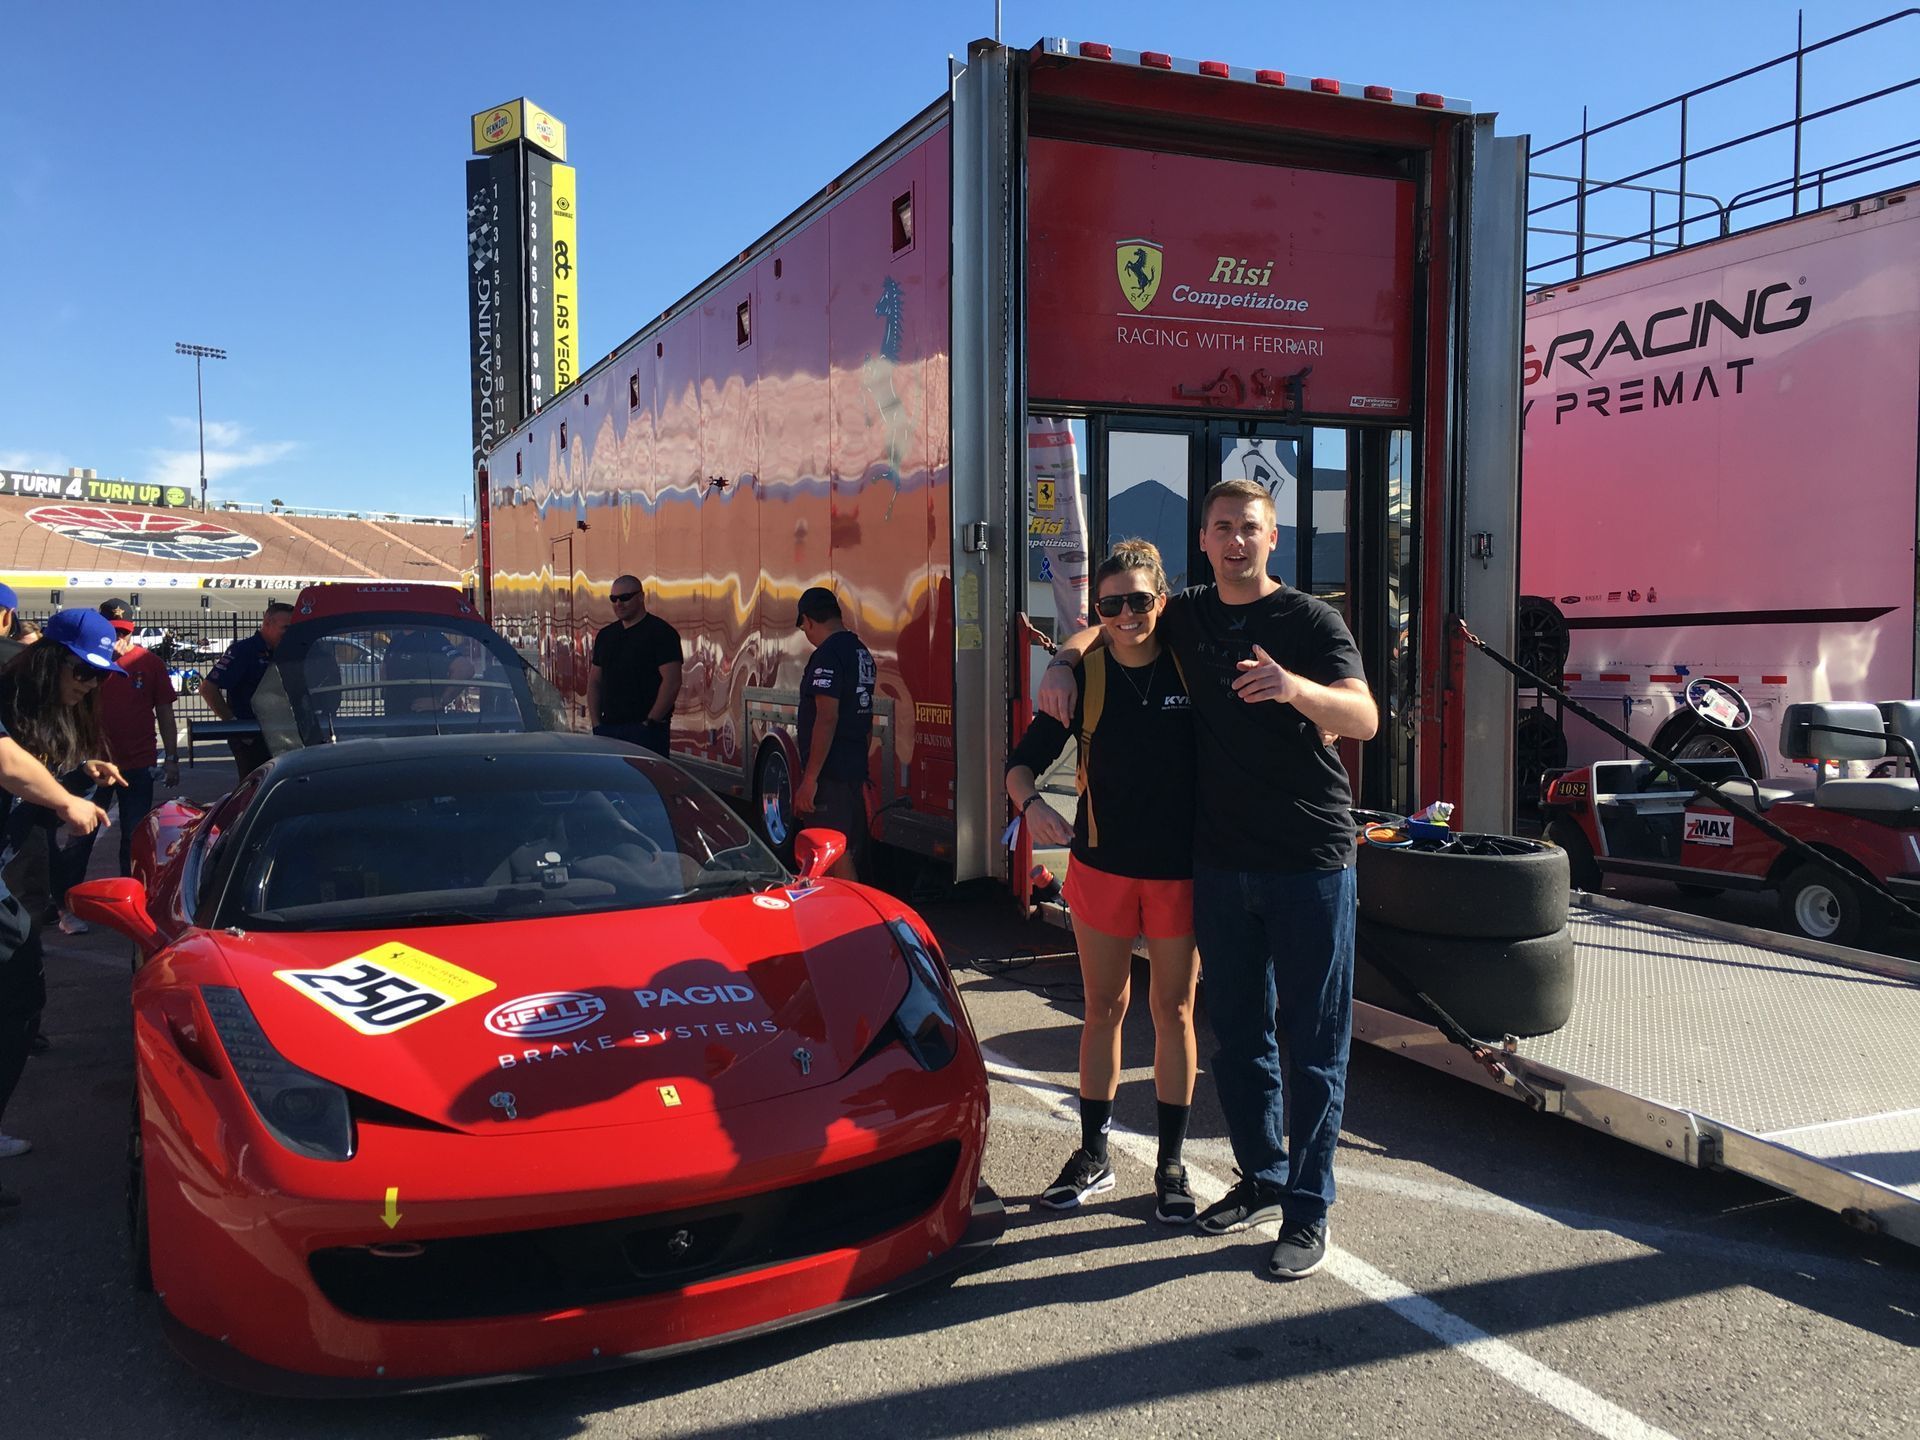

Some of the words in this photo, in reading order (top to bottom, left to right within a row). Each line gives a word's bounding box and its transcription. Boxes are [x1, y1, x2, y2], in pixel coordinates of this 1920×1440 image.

[493, 183, 498, 199] 1
[531, 180, 536, 196] 1
[493, 205, 498, 220] 2
[531, 201, 537, 218] 2
[493, 226, 499, 242] 3
[531, 223, 537, 239] 3
[494, 248, 499, 263] 4
[532, 245, 537, 261] 4
[494, 270, 500, 285] 5
[532, 266, 537, 282] 5
[1209, 256, 1275, 287] Risi
[494, 291, 500, 306] 6
[532, 287, 538, 303] 6
[1172, 284, 1309, 313] Competizione
[532, 309, 538, 325] 7
[556, 294, 569, 330] LAS
[495, 313, 500, 328] 7
[495, 333, 501, 349] 8
[533, 330, 539, 347] 8
[1117, 326, 1189, 349] RACING
[1196, 332, 1245, 352] WITH
[1253, 336, 1323, 357] FERRARI
[496, 355, 501, 370] 9
[533, 352, 539, 368] 9
[557, 335, 570, 391] VEGA
[494, 376, 504, 391] 10
[531, 373, 542, 390] 10
[1555, 357, 1754, 425] PREMAT
[495, 397, 505, 412] 11
[495, 419, 505, 434] 12
[11, 473, 61, 494] TURN
[65, 477, 82, 498] 4
[88, 481, 135, 500] TURN
[139, 485, 161, 501] UP
[1030, 517, 1065, 535] Risi
[208, 578, 217, 588] 4
[234, 578, 257, 589] LAS
[261, 579, 297, 589] VEGAS
[915, 702, 952, 725] Ferrari
[1560, 783, 1586, 795] 4082
[292, 964, 447, 1026] 250
[633, 985, 754, 1008] PAGID
[496, 997, 606, 1028] HELLA
[498, 1035, 616, 1069] BRAKE
[632, 1020, 778, 1043] SYSTEMS
